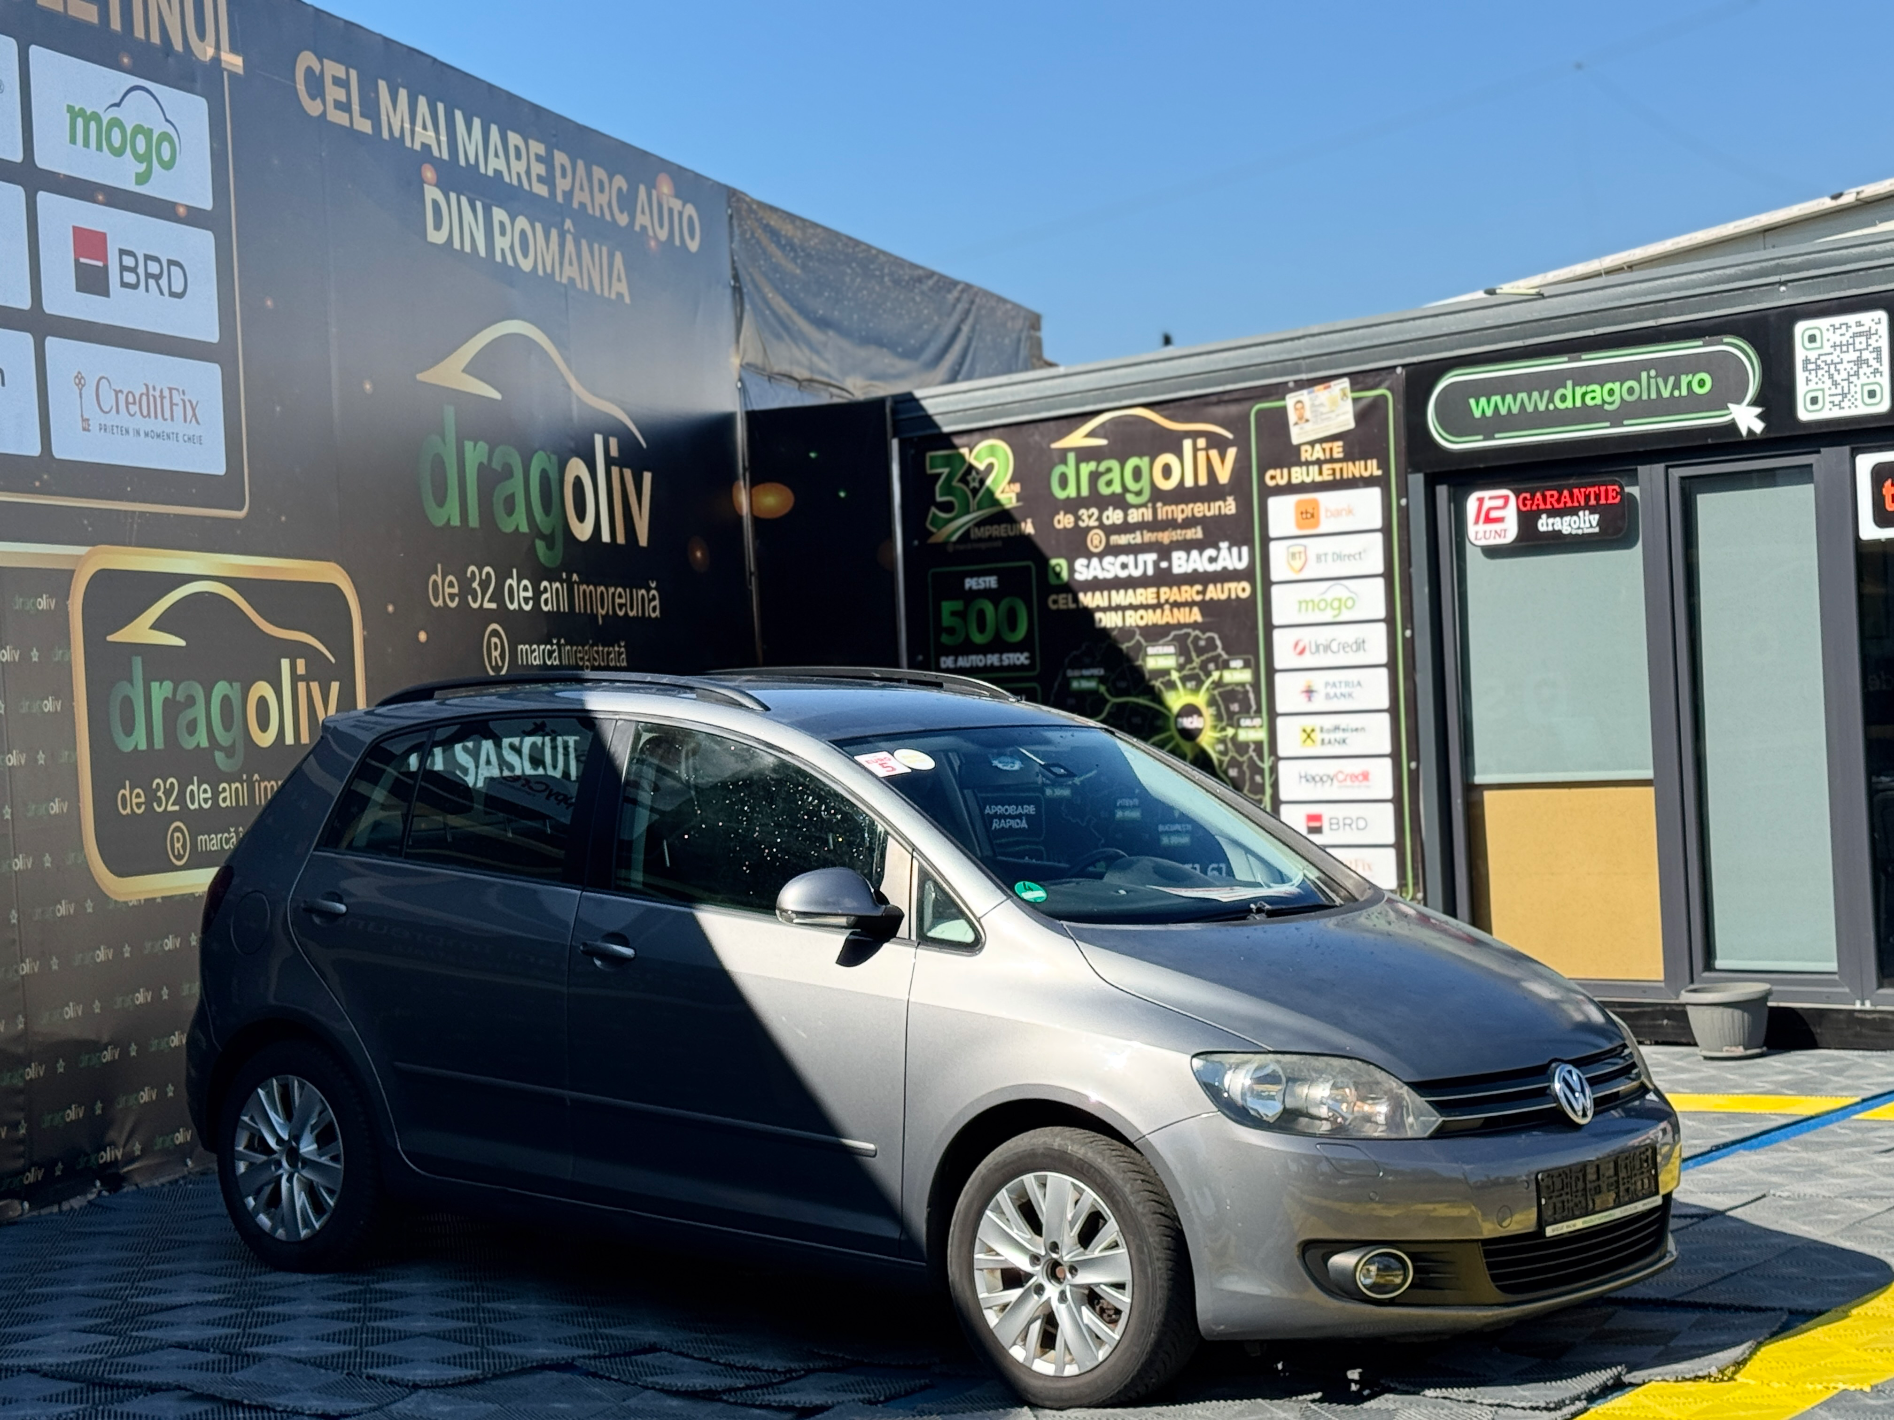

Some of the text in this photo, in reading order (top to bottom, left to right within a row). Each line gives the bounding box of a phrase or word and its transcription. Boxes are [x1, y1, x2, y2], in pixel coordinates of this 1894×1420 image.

[66, 104, 178, 186] mogo
[295, 50, 700, 253] CEL MAI MARE PARC AUTO
[423, 183, 630, 304] DIN ROMÂNIA
[118, 248, 189, 299] BRD
[95, 376, 201, 425] CreditFix
[1468, 368, 1713, 419] www.dragoliv.ro
[98, 423, 203, 446] PRIETEN IN MOMENTE CHEIE
[1301, 441, 1344, 461] RATE
[1050, 438, 1238, 505] dragoliv
[1264, 459, 1383, 487] CU BULETINUL
[420, 404, 653, 568] dragoliv
[926, 438, 1017, 533] 32
[1517, 485, 1621, 511] GARANTIE
[1053, 496, 1237, 529] de 32 de ani împreună
[1300, 507, 1315, 521] tbi
[1325, 504, 1355, 519] bank
[1473, 494, 1510, 526] 12
[1537, 510, 1600, 535] dragoliv
[1109, 531, 1142, 546] marcă
[1474, 528, 1507, 541] LUNI
[1074, 553, 1158, 581] SASCUT
[1171, 541, 1250, 574] BACĂU
[1315, 551, 1362, 564] BT Direct
[429, 563, 660, 625] de 32 de ani împreună
[964, 576, 998, 590] PESTE
[1048, 581, 1251, 610] CEL MAI MARE PARC AUTO
[1094, 604, 1203, 629] DIN ROMÂNIA
[1298, 596, 1356, 618] mogo
[940, 596, 1028, 646] 500
[517, 638, 560, 666] marcă
[561, 638, 627, 672] înregistrată
[1308, 638, 1367, 655] UniCredit
[940, 652, 1030, 669] DE AUTO PE STOC
[1324, 680, 1362, 690] PATRIA
[1325, 691, 1354, 701] BANK
[108, 656, 340, 773] dragoliv
[1320, 737, 1349, 746] BANK
[454, 736, 580, 788] SASCUT
[878, 762, 897, 773] 5
[1298, 770, 1371, 787] HappyCredit
[118, 780, 145, 815] de
[152, 777, 180, 812] 32
[186, 776, 212, 810] de
[218, 774, 248, 807] ani
[984, 804, 1036, 815] APROBARE
[992, 816, 1028, 830] RAPIDĂ
[1329, 817, 1368, 831] BRD
[197, 826, 237, 853] marcă
